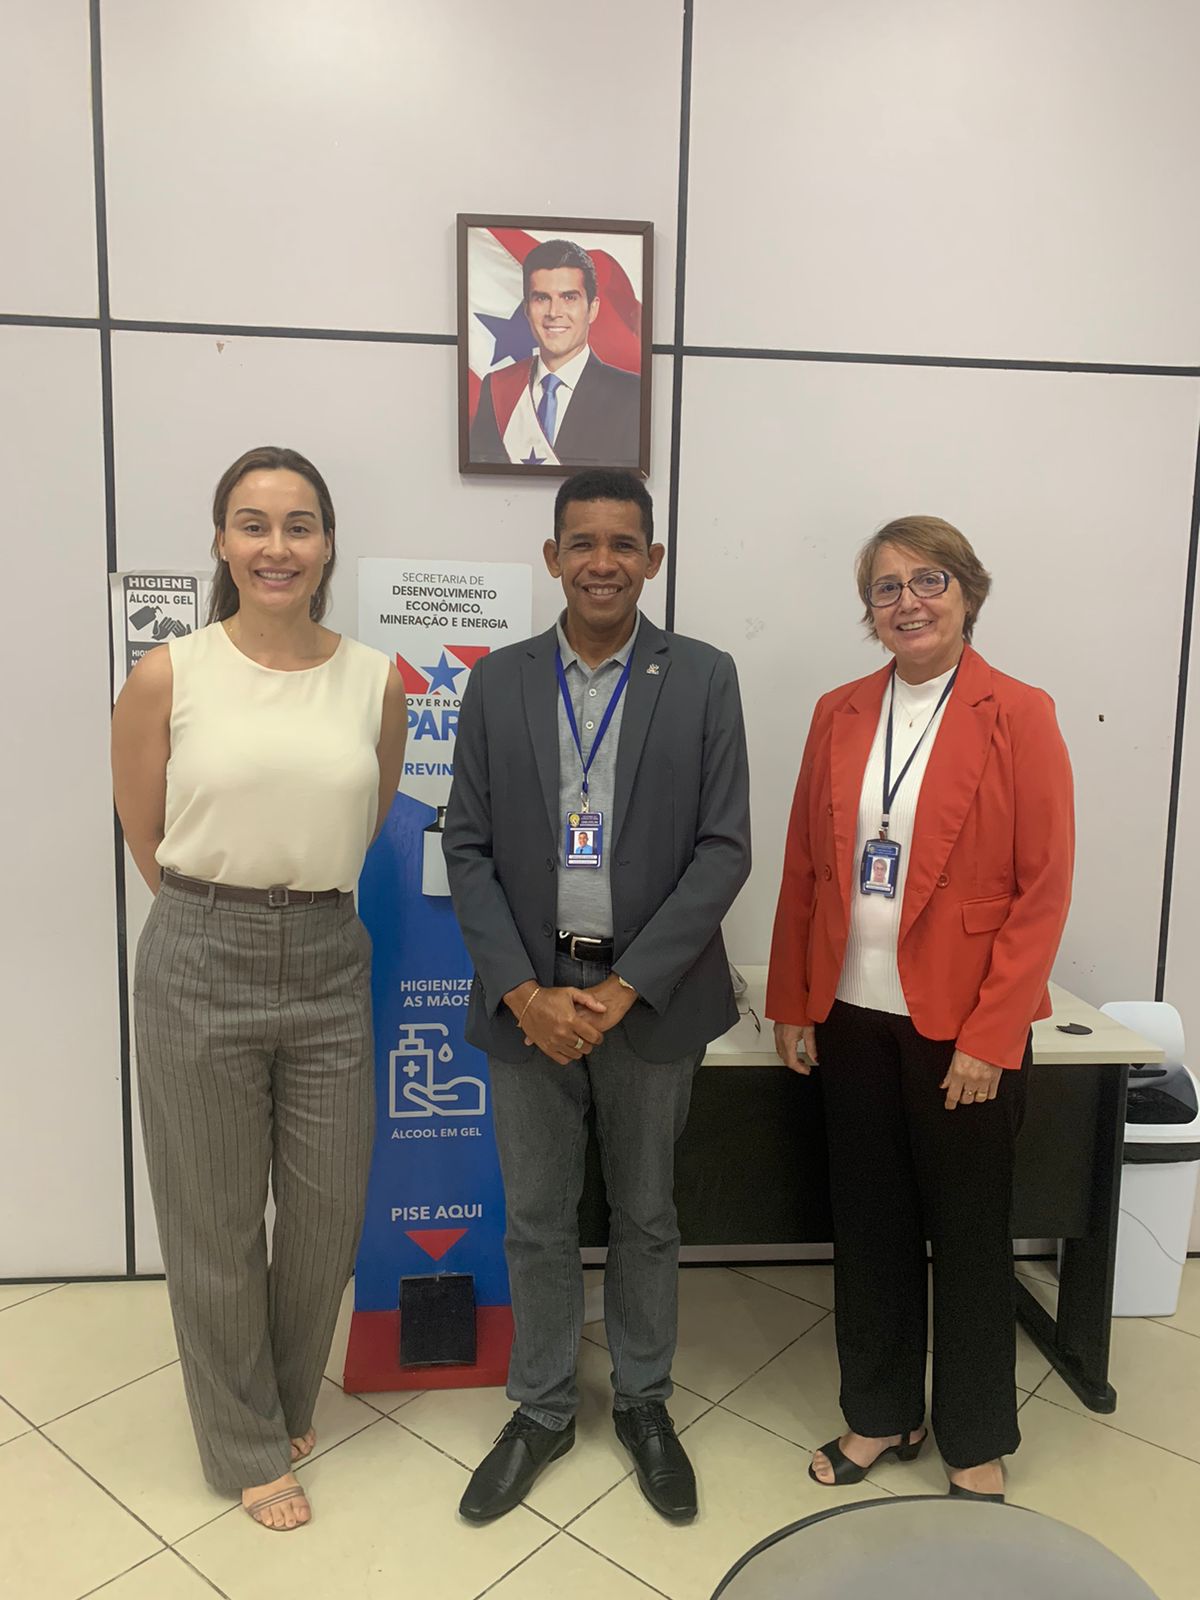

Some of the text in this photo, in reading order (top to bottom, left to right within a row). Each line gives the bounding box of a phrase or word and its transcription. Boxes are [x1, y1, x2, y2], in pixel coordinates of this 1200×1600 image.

[128, 577, 192, 589] HIGIENE
[402, 572, 485, 586] SECRETARIA DE
[129, 592, 193, 605] ÁLCOOL GEL
[392, 585, 497, 600] DESENVOLVIMENTO
[405, 599, 483, 615] ECONÔMICO,
[379, 614, 508, 629] MINERAÇÃO E ENERGIA
[406, 698, 462, 707] OVERNO
[407, 709, 459, 740] PAR
[404, 763, 454, 775] REVIN
[403, 992, 470, 1008] AS MÃOS
[391, 1127, 482, 1139] ÁLCOOL EM GEL
[391, 1204, 483, 1222] PISE AQUI
